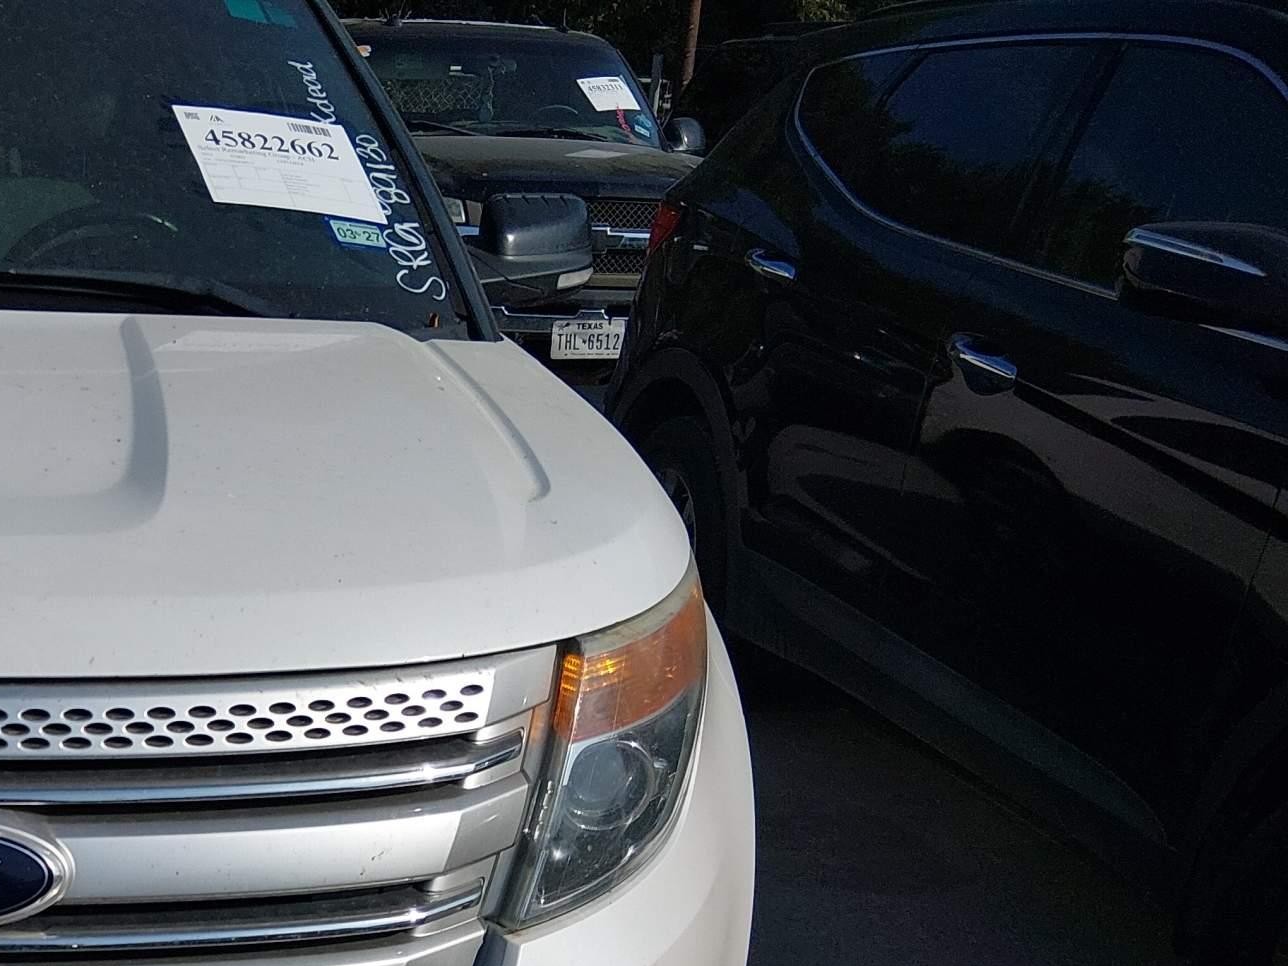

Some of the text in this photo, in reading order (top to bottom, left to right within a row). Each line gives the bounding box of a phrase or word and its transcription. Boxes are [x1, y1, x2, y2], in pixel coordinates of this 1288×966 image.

[204, 128, 340, 161] 45822662
[336, 226, 357, 240] 03
[362, 230, 380, 243] 27
[576, 322, 604, 330] TEXAS
